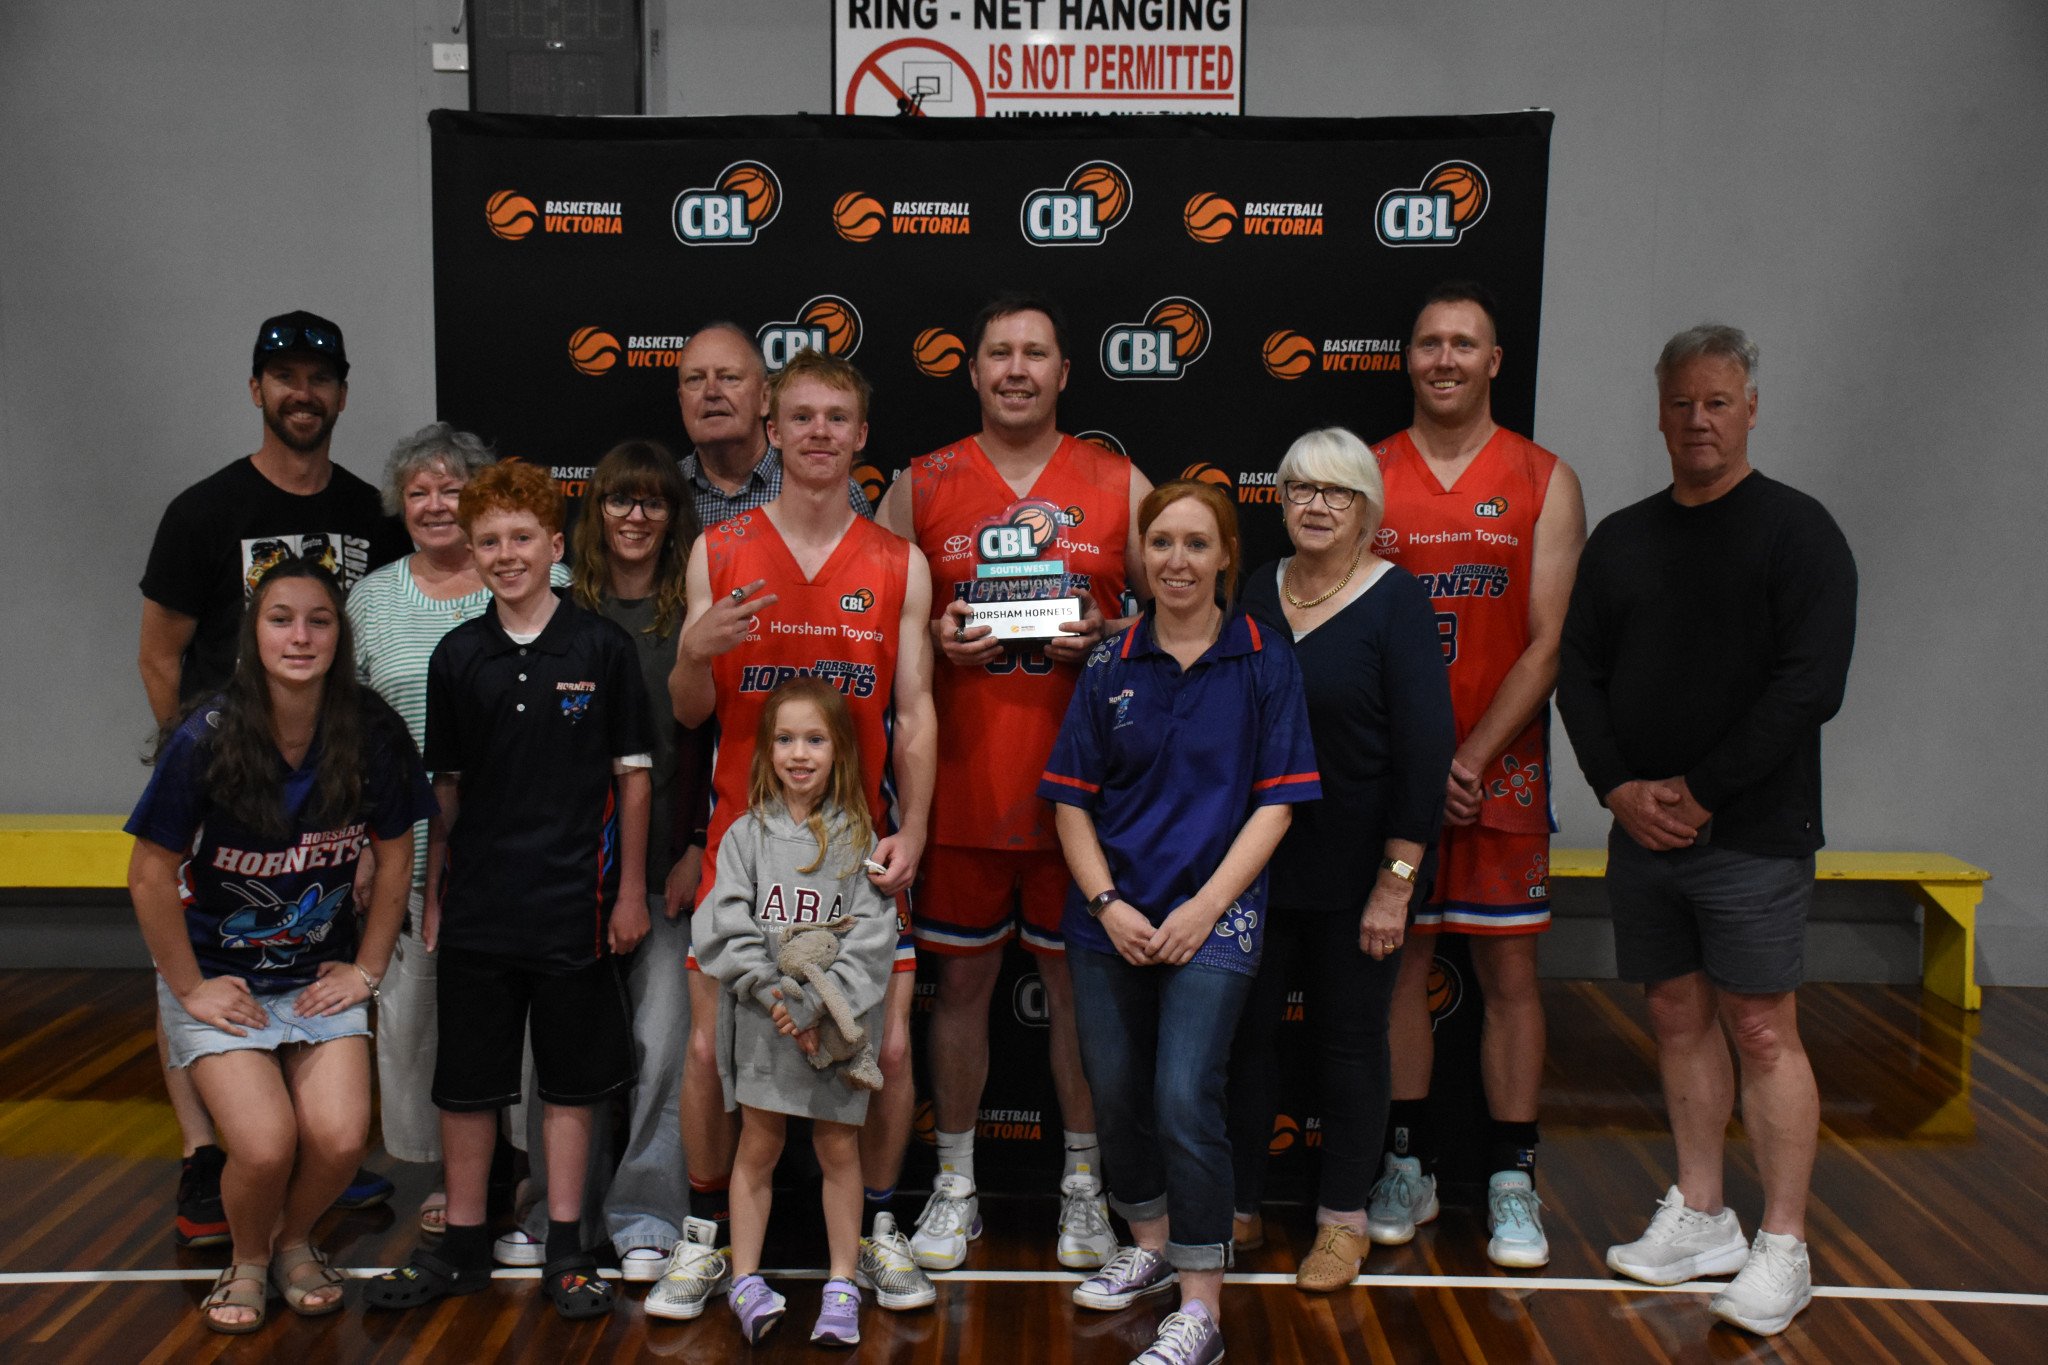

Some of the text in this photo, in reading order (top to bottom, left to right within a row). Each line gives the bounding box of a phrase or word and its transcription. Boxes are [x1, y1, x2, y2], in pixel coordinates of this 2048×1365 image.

[849, 0, 938, 30] RING
[974, 0, 1046, 30] NET
[1059, 0, 1231, 32] HANGING
[988, 44, 1235, 91] IS NOT PERMITTED
[545, 200, 622, 216] BASKETBALL
[892, 201, 970, 217] BASKETBALL
[1244, 202, 1324, 217] BASKETBALL
[544, 215, 623, 234] VICTORIA
[680, 196, 751, 239] CBL
[892, 216, 970, 235] VICTORIA
[1027, 196, 1099, 239] CBL
[1244, 217, 1324, 236] VICTORIA
[1381, 196, 1456, 240] CBL
[1107, 329, 1180, 373] CBL
[1323, 338, 1401, 352] BASKETBALL
[1322, 353, 1401, 371] VICTORIA
[1476, 503, 1499, 517] CBL
[982, 526, 1038, 559] CBL
[1055, 537, 1100, 555] Toyota
[1409, 529, 1519, 547] Horsham Toyota
[990, 564, 1051, 575] SOUTH WEST
[1452, 564, 1508, 576] HORSHAM
[981, 579, 1063, 592] CHAMPIONS
[841, 596, 865, 611] CBL
[972, 607, 1073, 620] HORSHAM HORNETS
[770, 621, 884, 643] Horsham Toyota
[814, 660, 876, 675] HORSHAM
[212, 838, 362, 877] HORNETS
[976, 1122, 1042, 1140] ICTORIA
